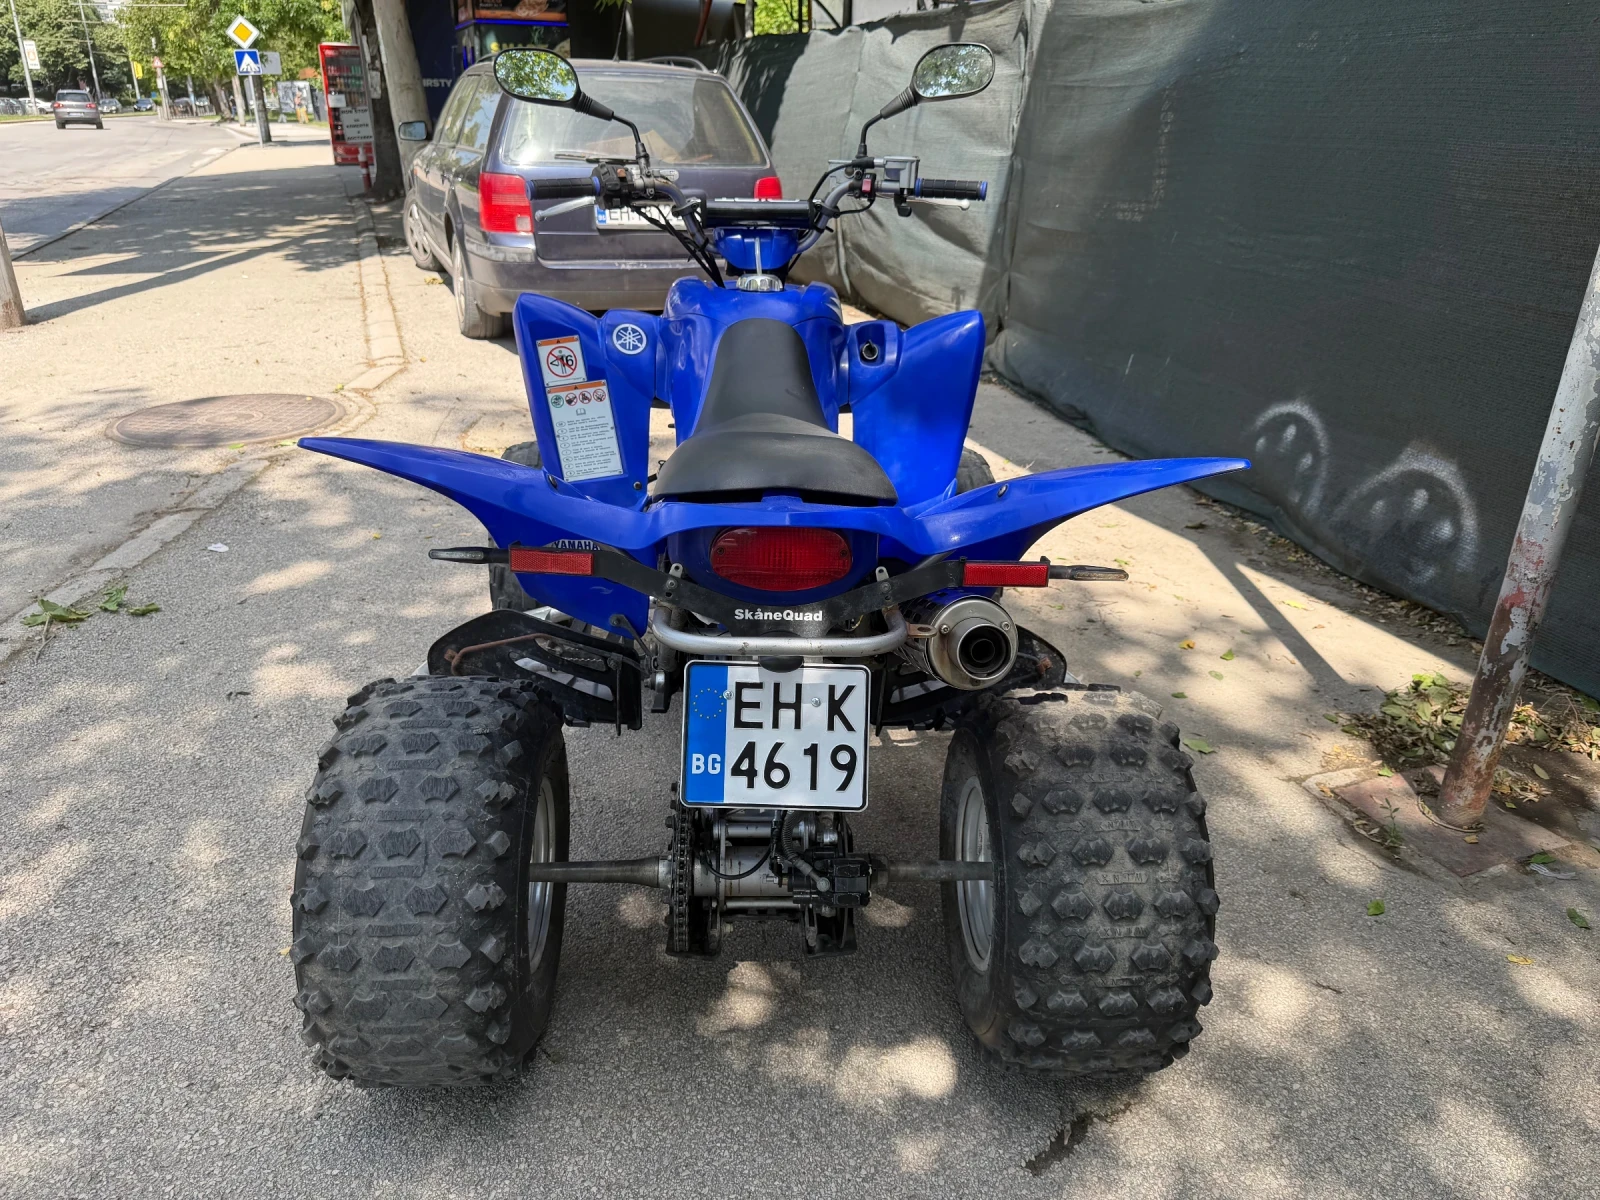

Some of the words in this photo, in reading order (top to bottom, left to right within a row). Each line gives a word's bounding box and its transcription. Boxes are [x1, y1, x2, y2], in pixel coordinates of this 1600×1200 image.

[423, 78, 452, 87] IRSTY
[554, 540, 601, 550] YAMAHA
[734, 608, 823, 621] SkåneQuad
[691, 753, 722, 775] BG
[730, 741, 857, 792] 4619
